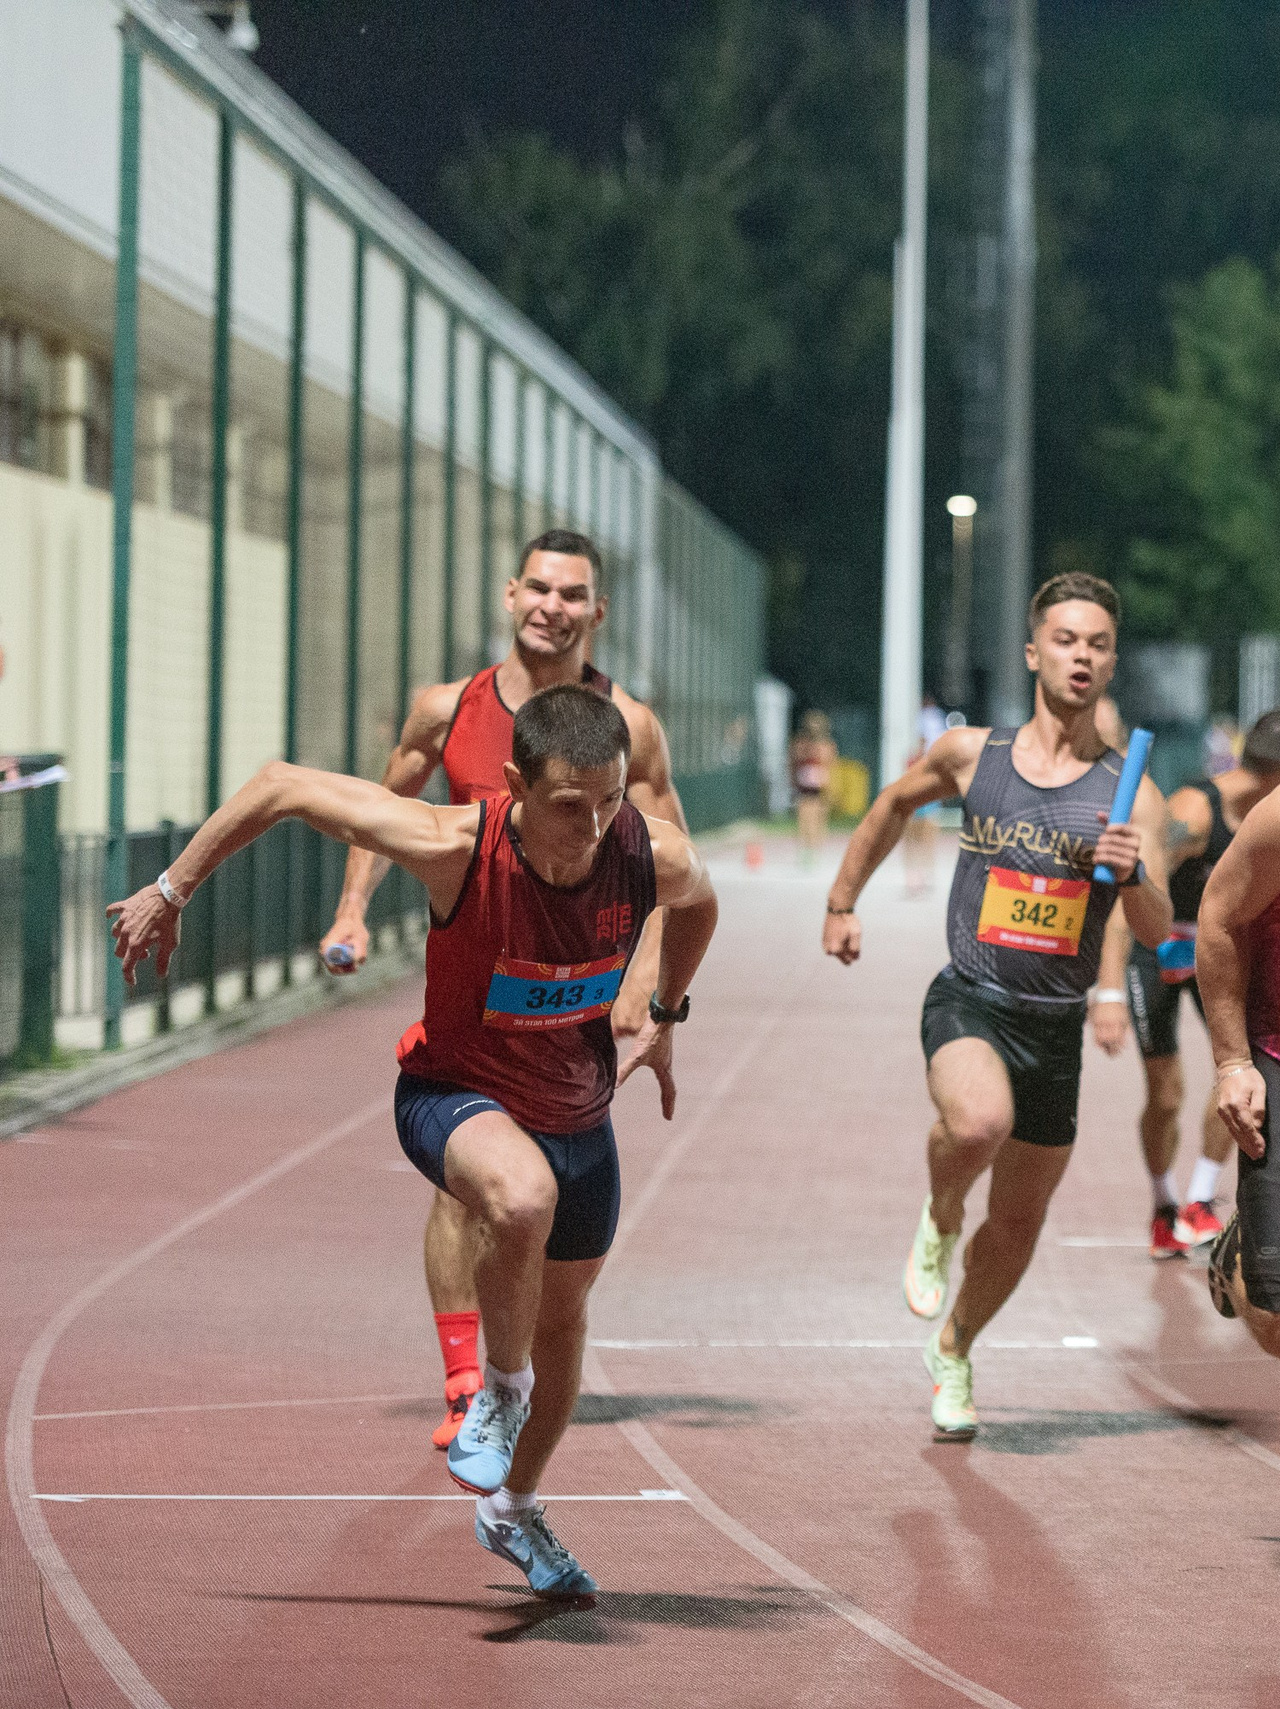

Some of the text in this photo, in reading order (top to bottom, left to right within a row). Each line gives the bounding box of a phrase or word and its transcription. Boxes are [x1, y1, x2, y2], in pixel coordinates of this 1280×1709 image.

[1011, 899, 1058, 928] 342
[525, 984, 604, 1009] 343 3
